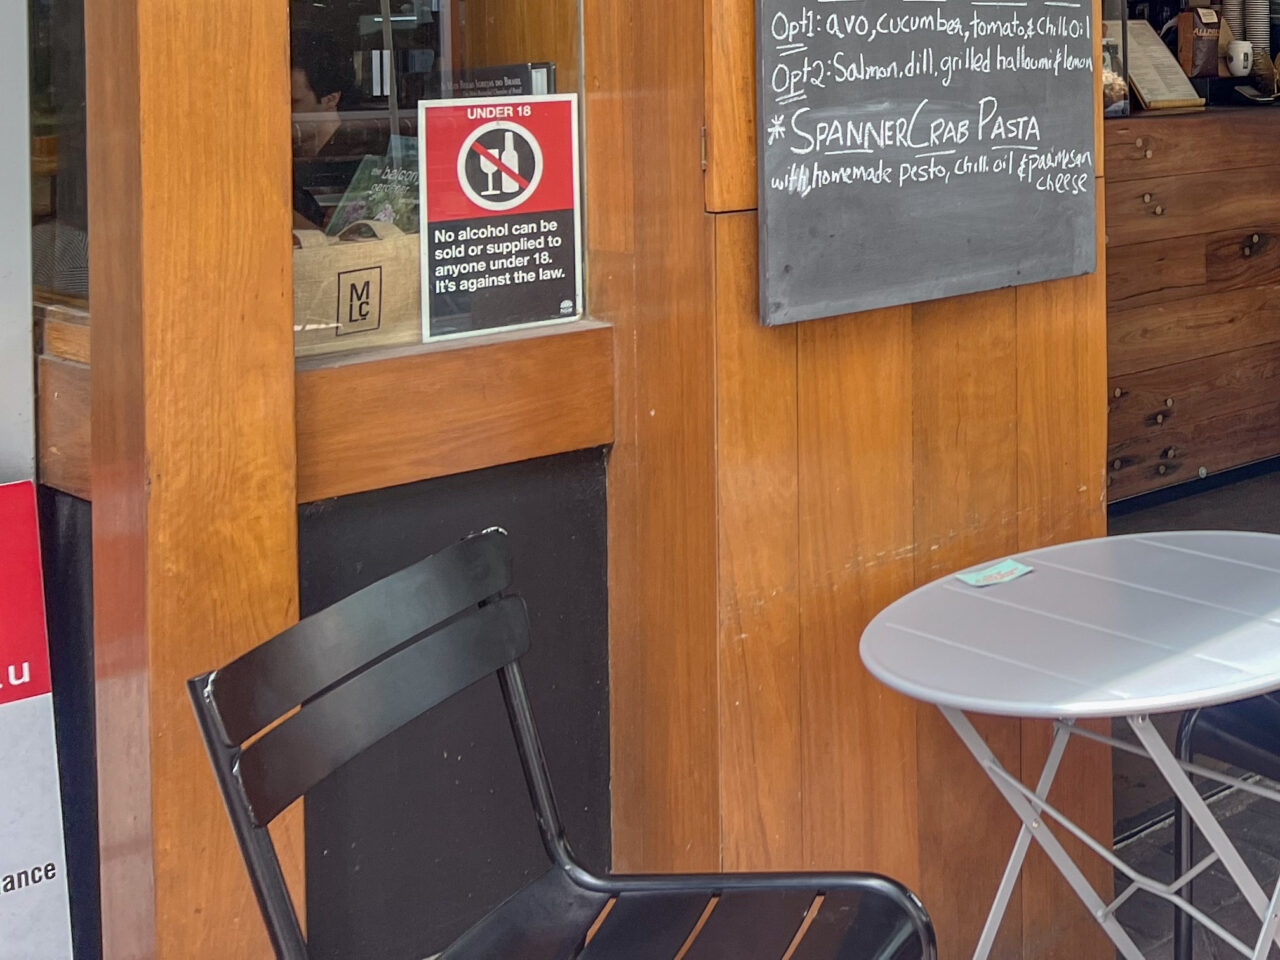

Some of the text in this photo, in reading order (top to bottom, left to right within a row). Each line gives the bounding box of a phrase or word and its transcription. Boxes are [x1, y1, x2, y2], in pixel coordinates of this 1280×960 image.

[940, 46, 990, 86] grilled
[1063, 44, 1093, 72] lemon
[467, 105, 531, 120] UNDER 18
[790, 107, 908, 154] SPANNER
[978, 96, 1040, 141] PASTA
[812, 159, 892, 188] homemade
[993, 151, 1013, 174] oil
[1036, 172, 1088, 195] cheese
[434, 220, 558, 243] No alcohol can be
[435, 235, 562, 260] sold or supplied to
[435, 252, 553, 277] anyone under 18.
[435, 268, 566, 294] It's against the law.
[0, 860, 57, 894] ance
